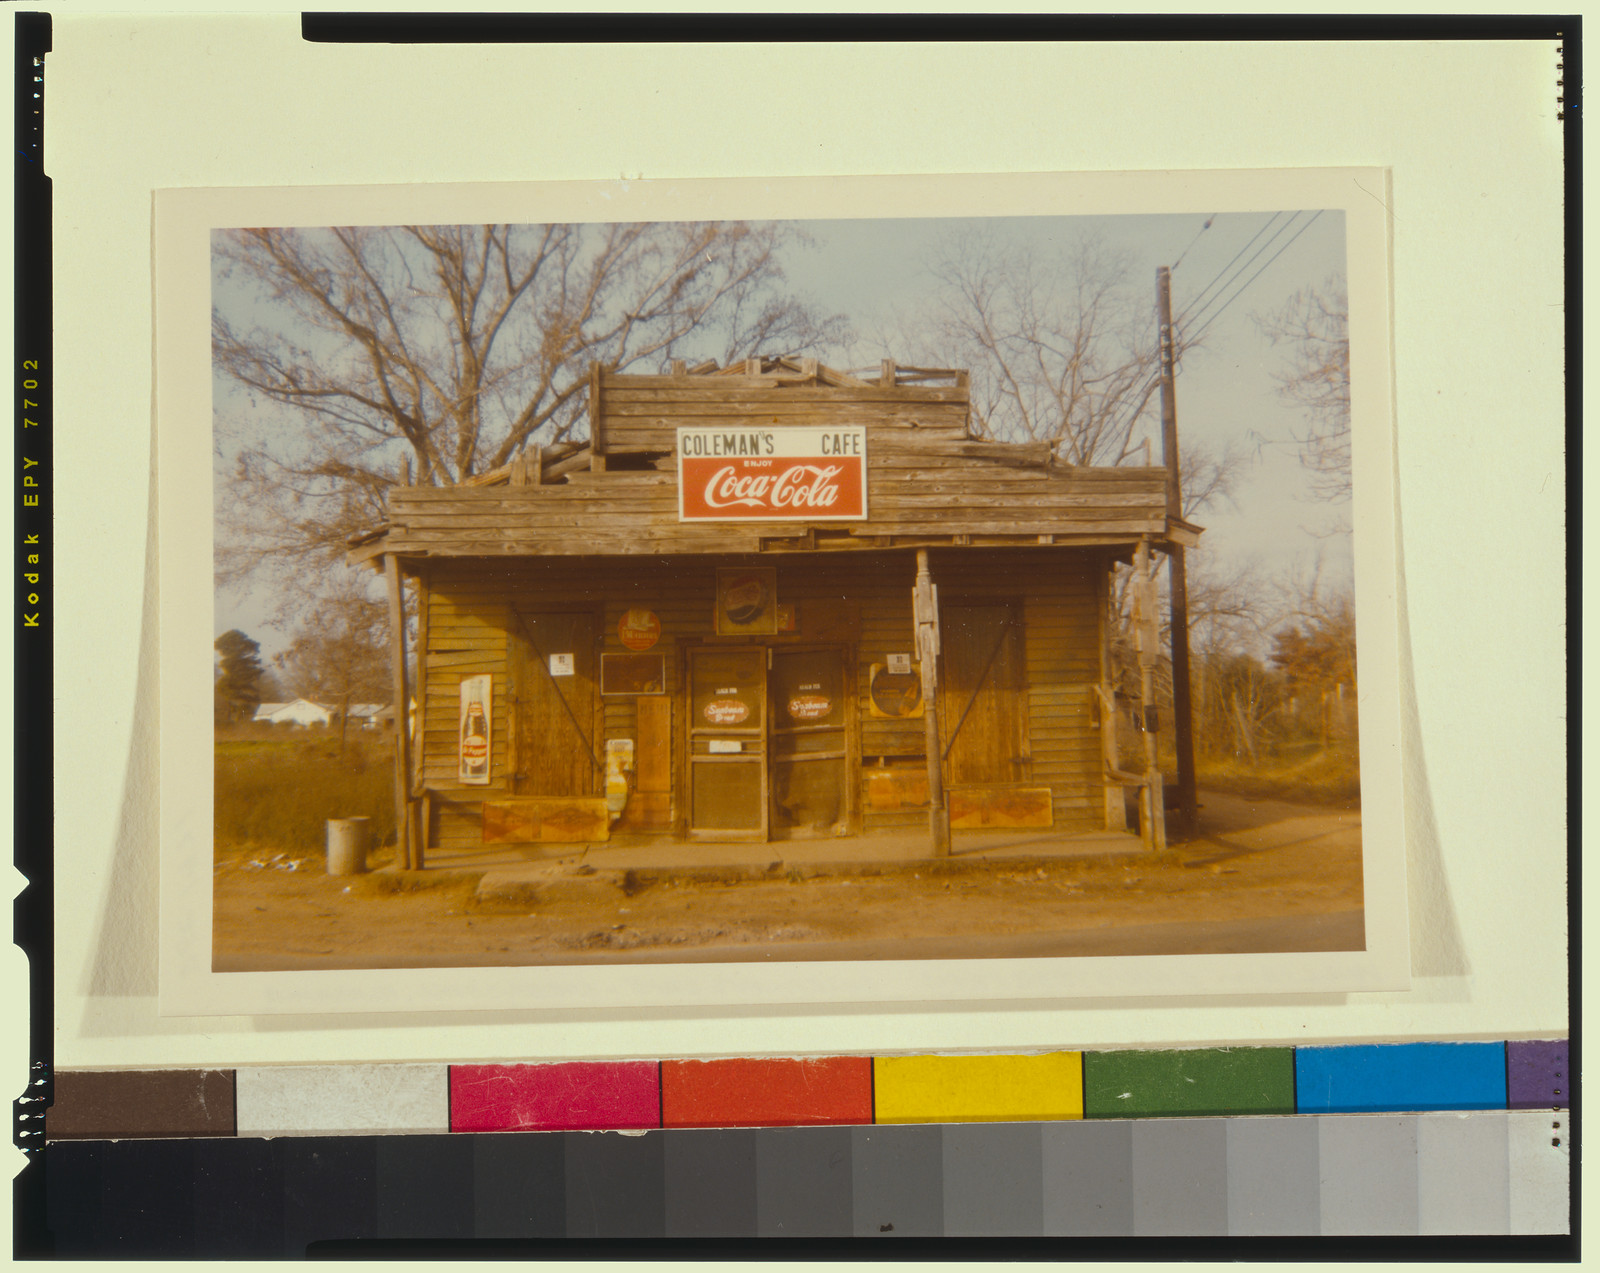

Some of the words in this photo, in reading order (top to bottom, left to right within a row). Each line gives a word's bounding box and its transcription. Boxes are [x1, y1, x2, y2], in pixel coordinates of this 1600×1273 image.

[23, 359, 39, 428] 7702
[683, 431, 775, 456] COLEMAN'S
[821, 433, 861, 455] CAFE
[23, 456, 39, 507] EPY
[704, 465, 844, 508] Coca-Cola
[24, 534, 40, 627] Kodak
